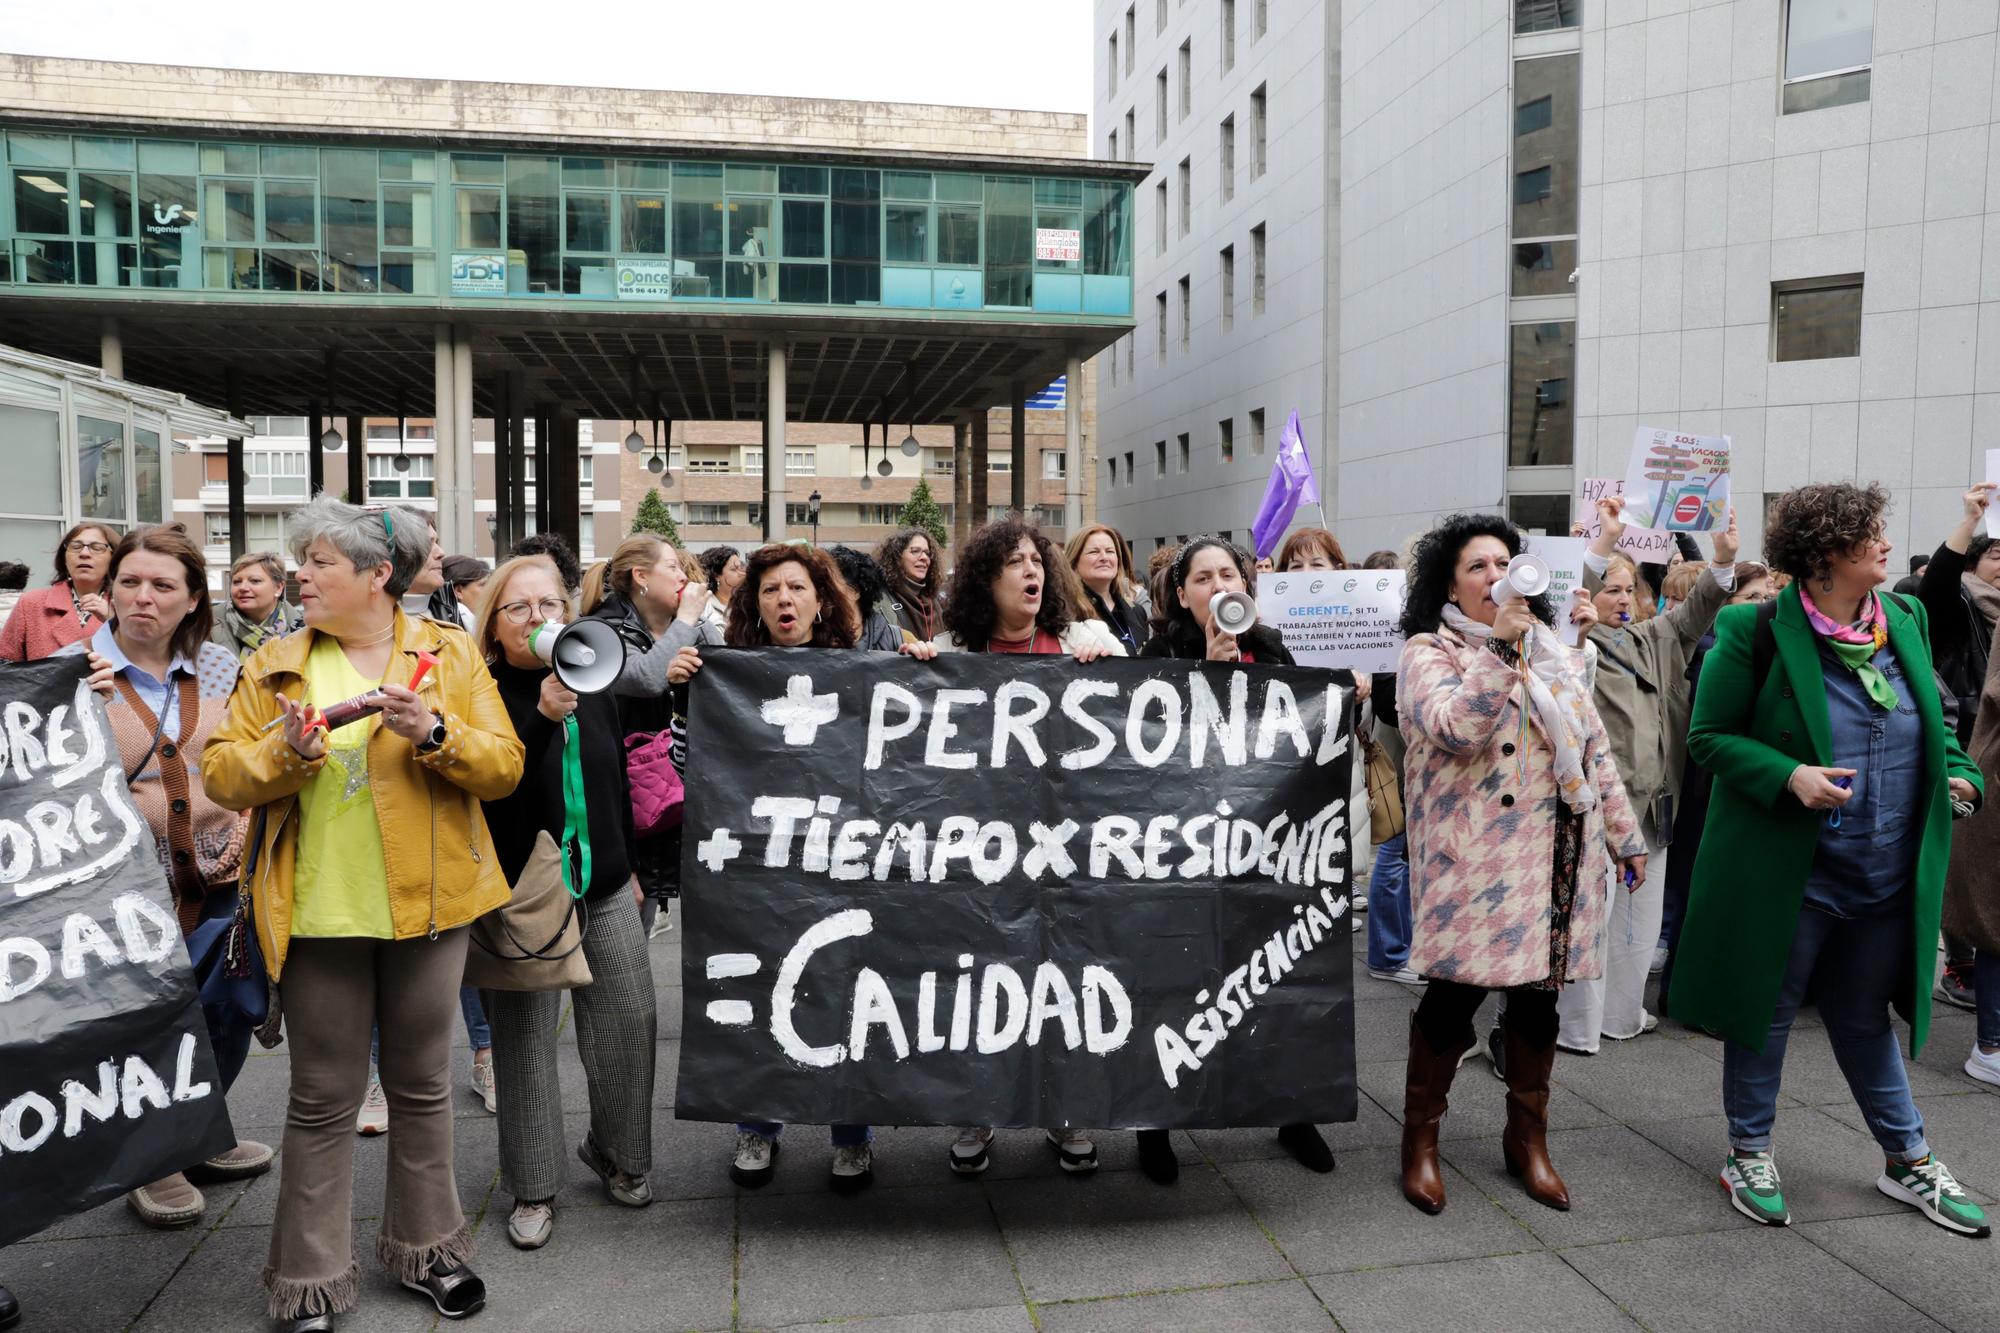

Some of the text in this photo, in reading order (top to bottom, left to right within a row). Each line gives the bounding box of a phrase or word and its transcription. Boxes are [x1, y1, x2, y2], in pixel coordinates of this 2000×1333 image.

[452, 263, 504, 280] JDH
[1277, 621, 1333, 630] TRABAJASTE
[1373, 619, 1390, 627] LOS
[1318, 643, 1336, 651] LAS
[1337, 641, 1394, 650] VACACIONES
[863, 670, 1349, 769] PERSONAL
